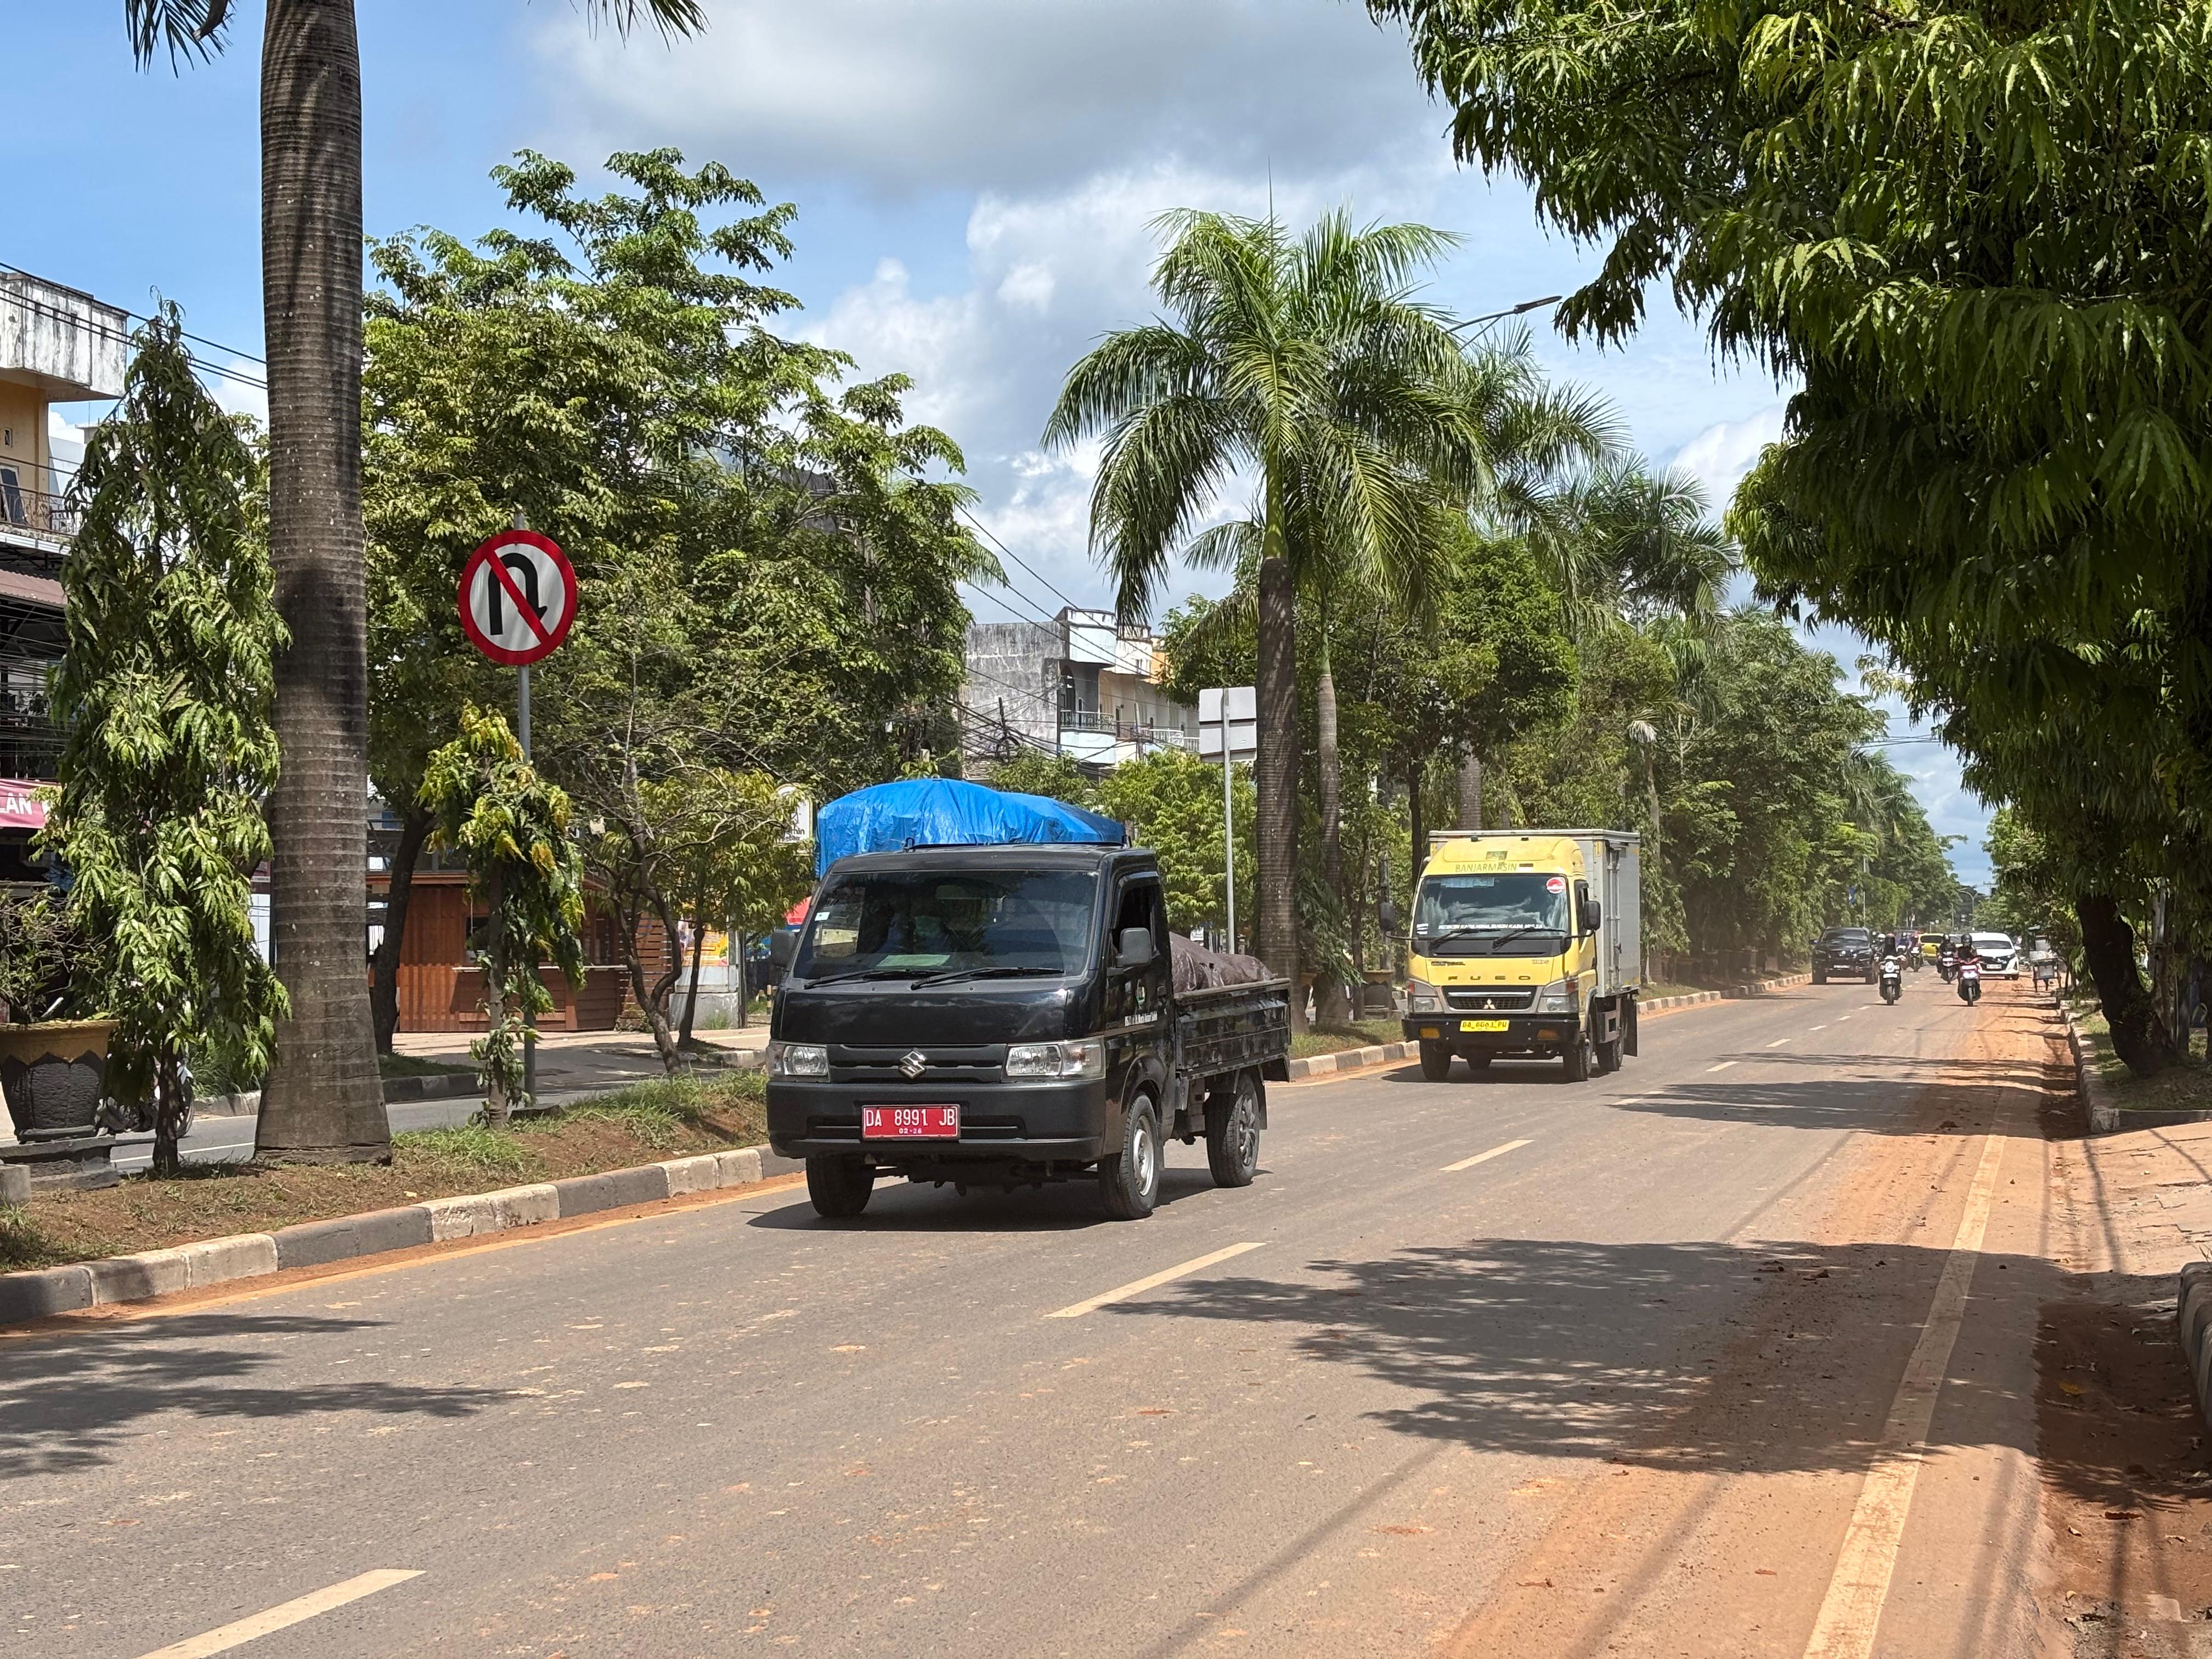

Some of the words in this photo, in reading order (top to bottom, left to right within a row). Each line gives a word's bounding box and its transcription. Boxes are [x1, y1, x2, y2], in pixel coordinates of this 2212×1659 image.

[1455, 862, 1517, 873] BANJARMASIN
[866, 1109, 882, 1127] DA
[894, 1109, 928, 1126] 8991
[939, 1108, 955, 1126] JB
